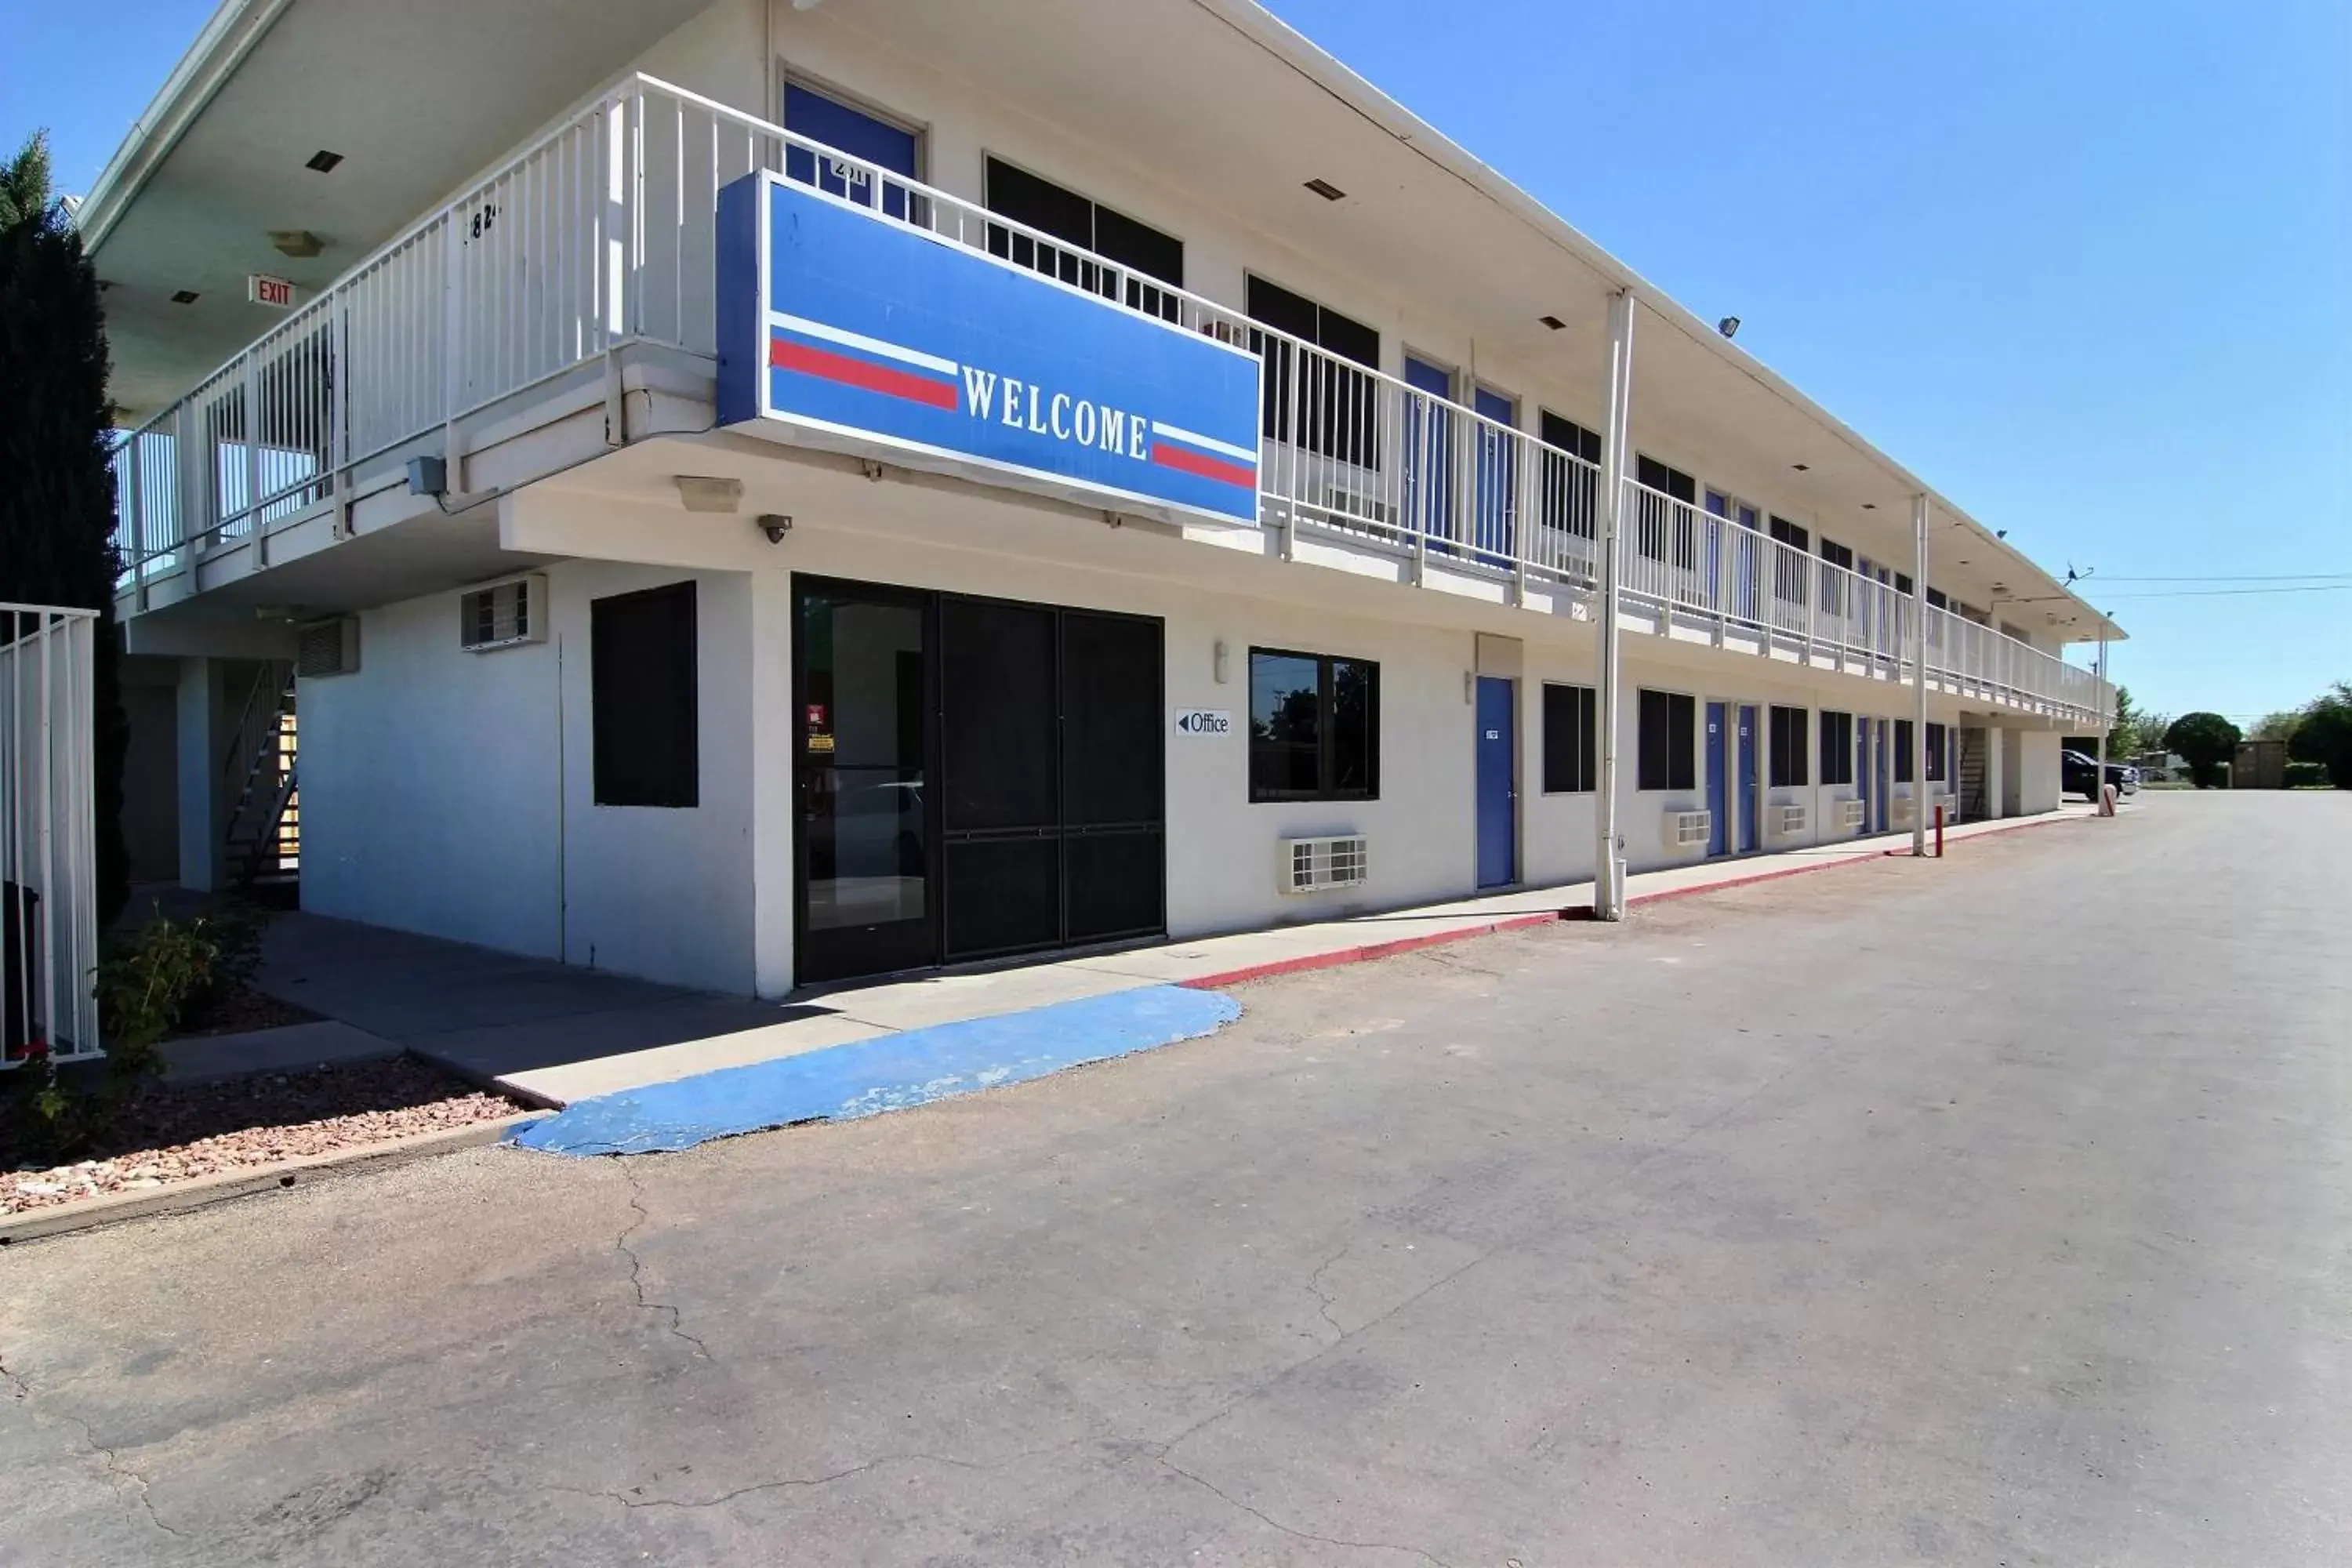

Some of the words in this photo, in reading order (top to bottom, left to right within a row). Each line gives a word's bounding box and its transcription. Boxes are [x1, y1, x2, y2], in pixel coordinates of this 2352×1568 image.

[260, 280, 289, 305] EXIT
[962, 365, 1147, 461] WELCOME
[1191, 713, 1229, 733] Office
